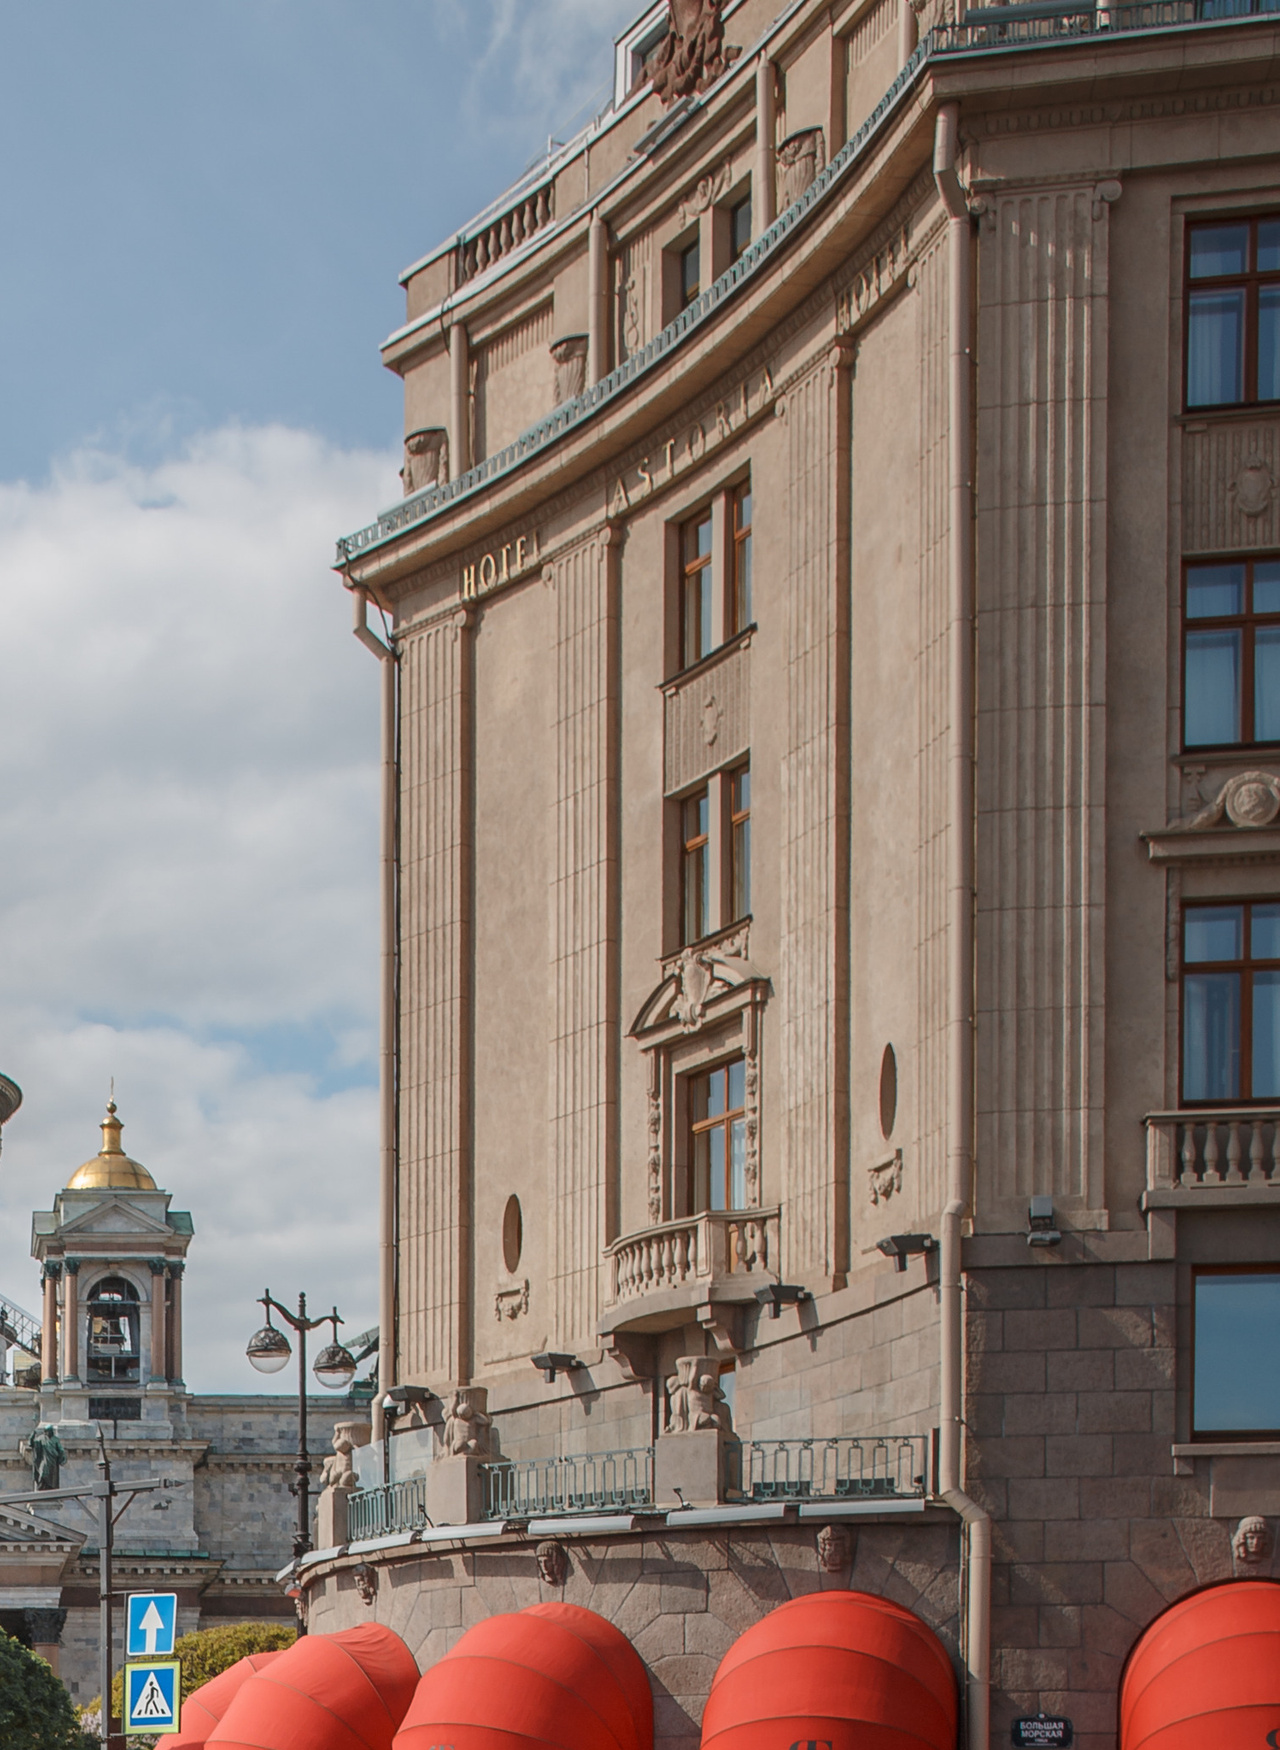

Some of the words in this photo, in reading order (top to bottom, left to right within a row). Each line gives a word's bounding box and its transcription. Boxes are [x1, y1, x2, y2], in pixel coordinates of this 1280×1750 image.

[462, 530, 539, 601] HOTEL
[607, 366, 773, 517] ASTORIA
[1019, 1721, 1064, 1730] БОЛЬШАЯ
[1020, 1730, 1063, 1738] МОРСКАЯ
